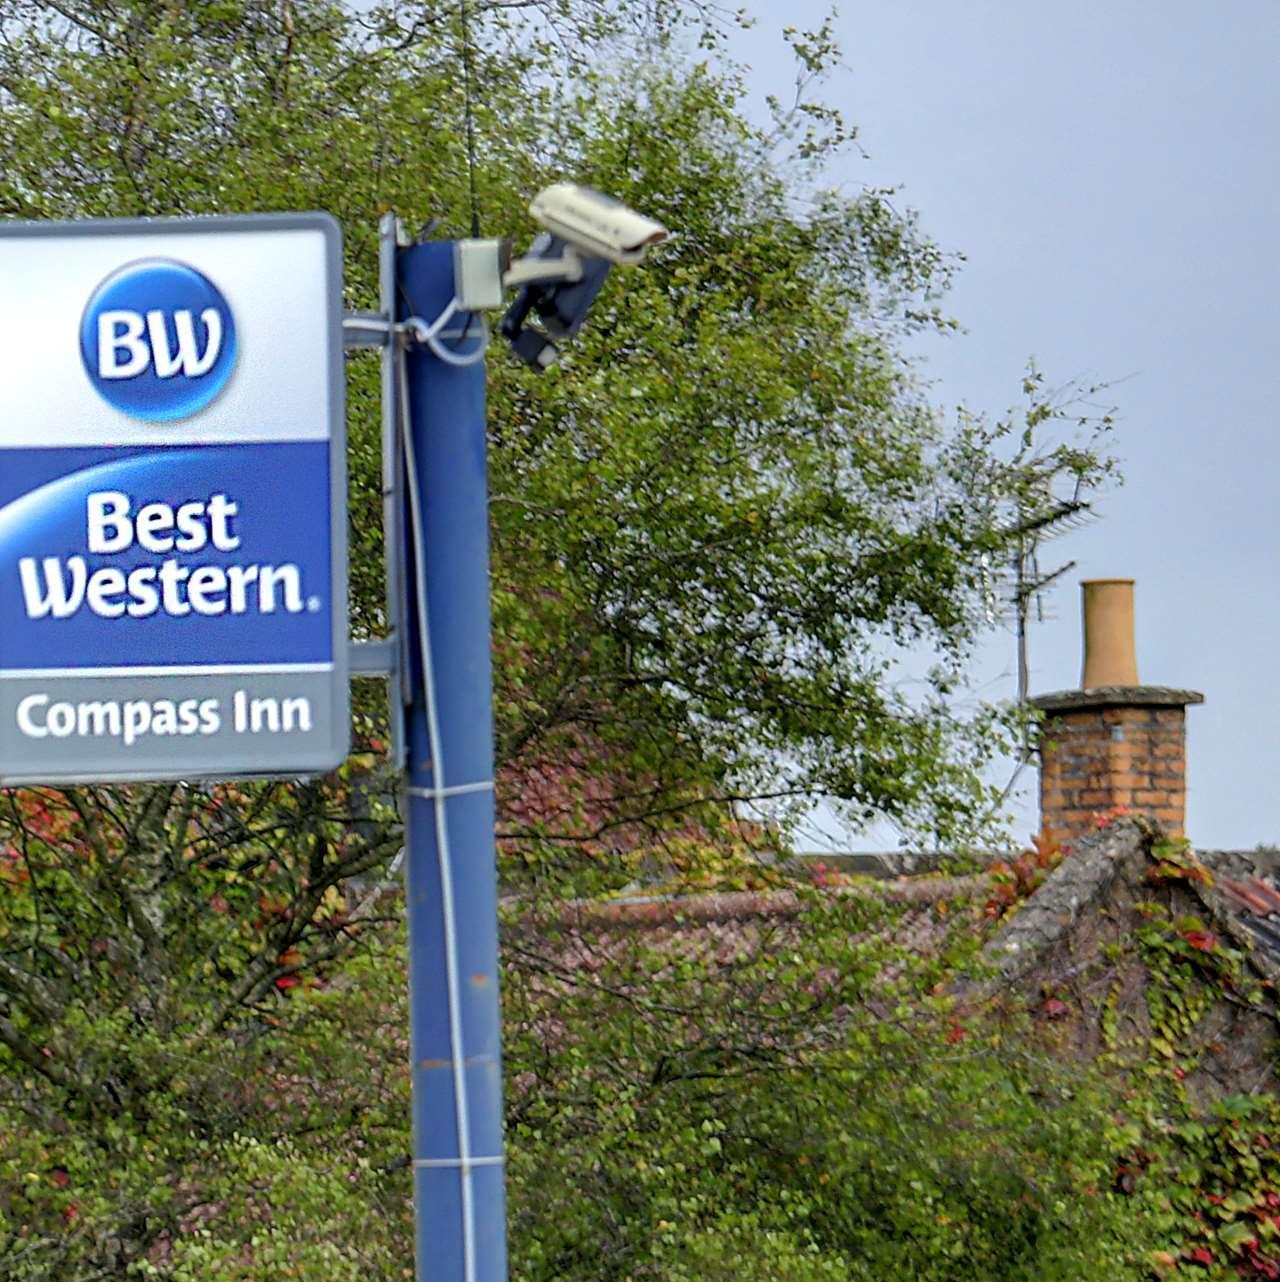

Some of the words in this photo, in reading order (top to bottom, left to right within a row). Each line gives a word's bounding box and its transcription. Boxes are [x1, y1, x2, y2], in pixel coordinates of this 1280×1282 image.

[97, 309, 222, 379] BW
[86, 491, 241, 553] Best
[16, 694, 221, 746] Compass
[233, 690, 312, 734] Inn
